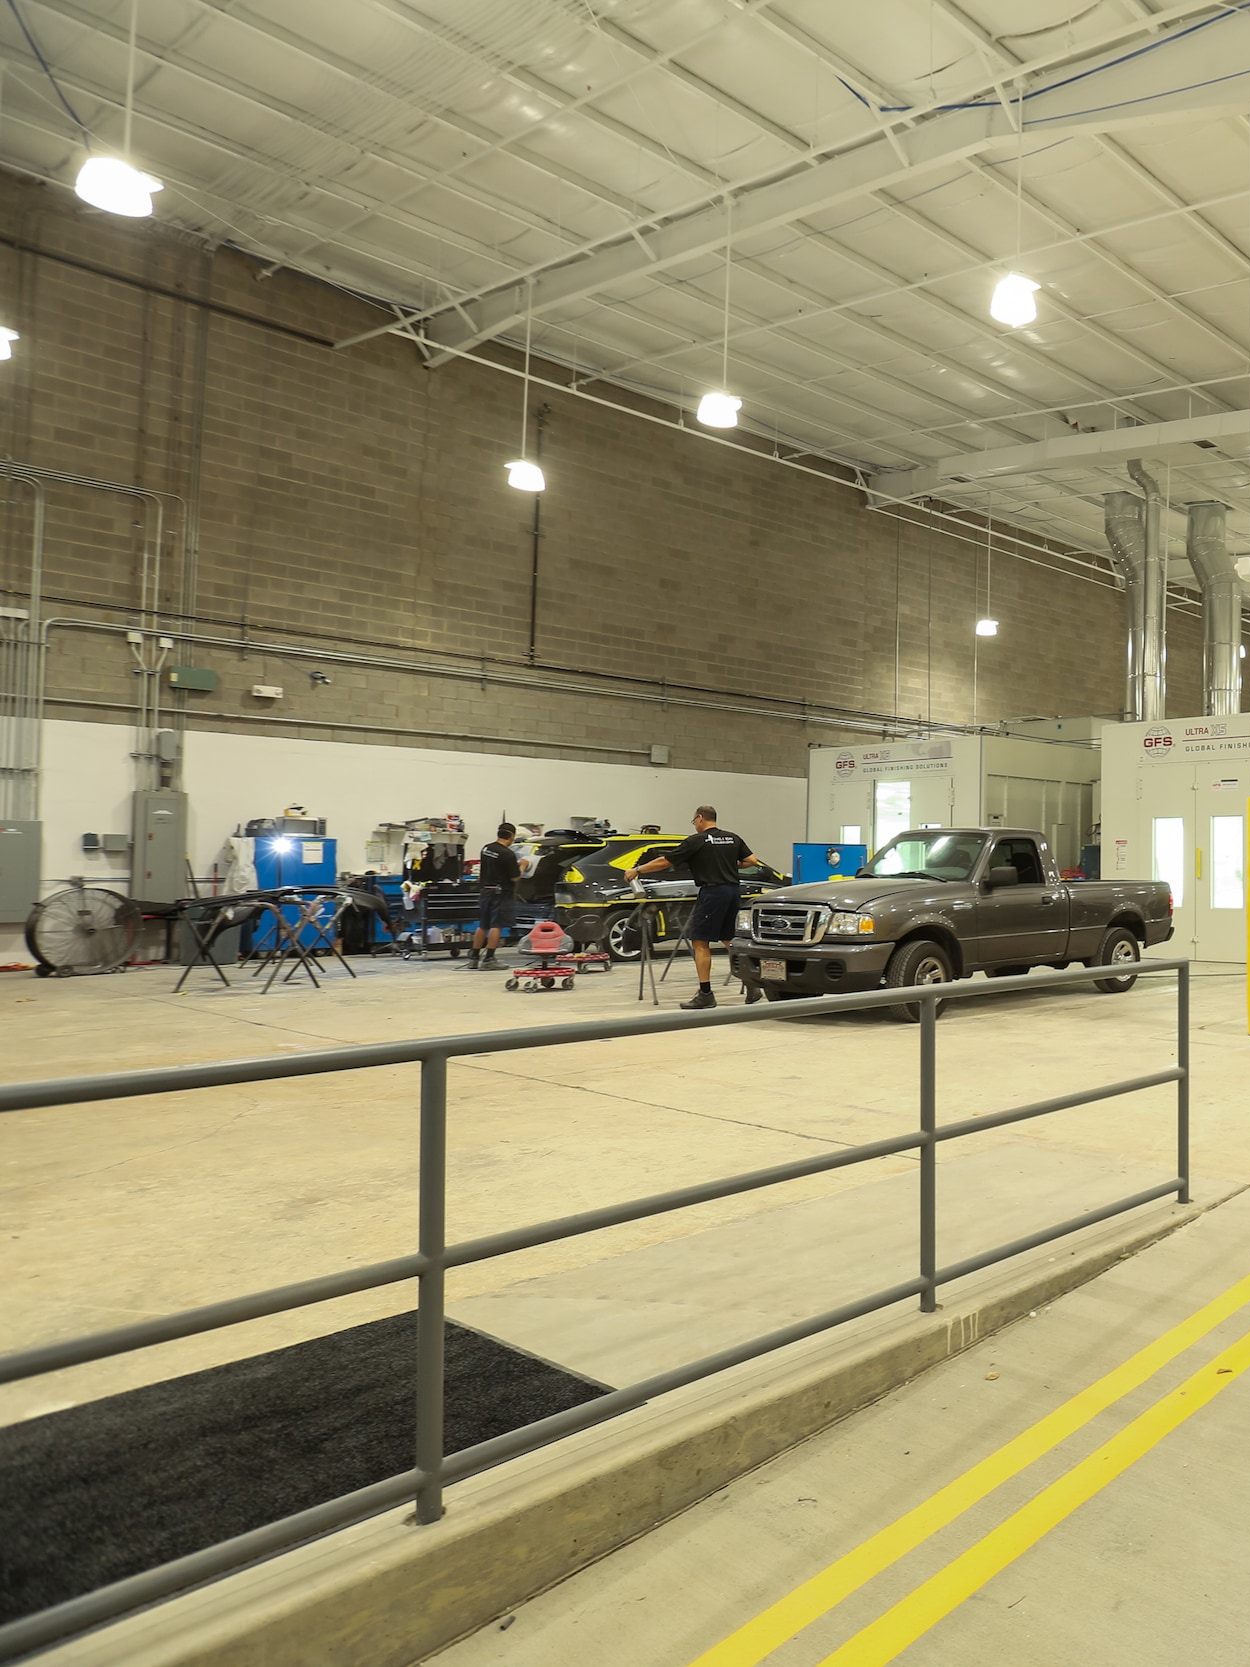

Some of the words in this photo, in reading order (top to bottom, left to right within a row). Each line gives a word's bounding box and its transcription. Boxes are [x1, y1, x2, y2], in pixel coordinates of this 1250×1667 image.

[1185, 727, 1209, 736] ULTRA
[1143, 736, 1173, 748] GFS
[1185, 744, 1216, 752] GLOBAL
[835, 760, 855, 769] GFS
